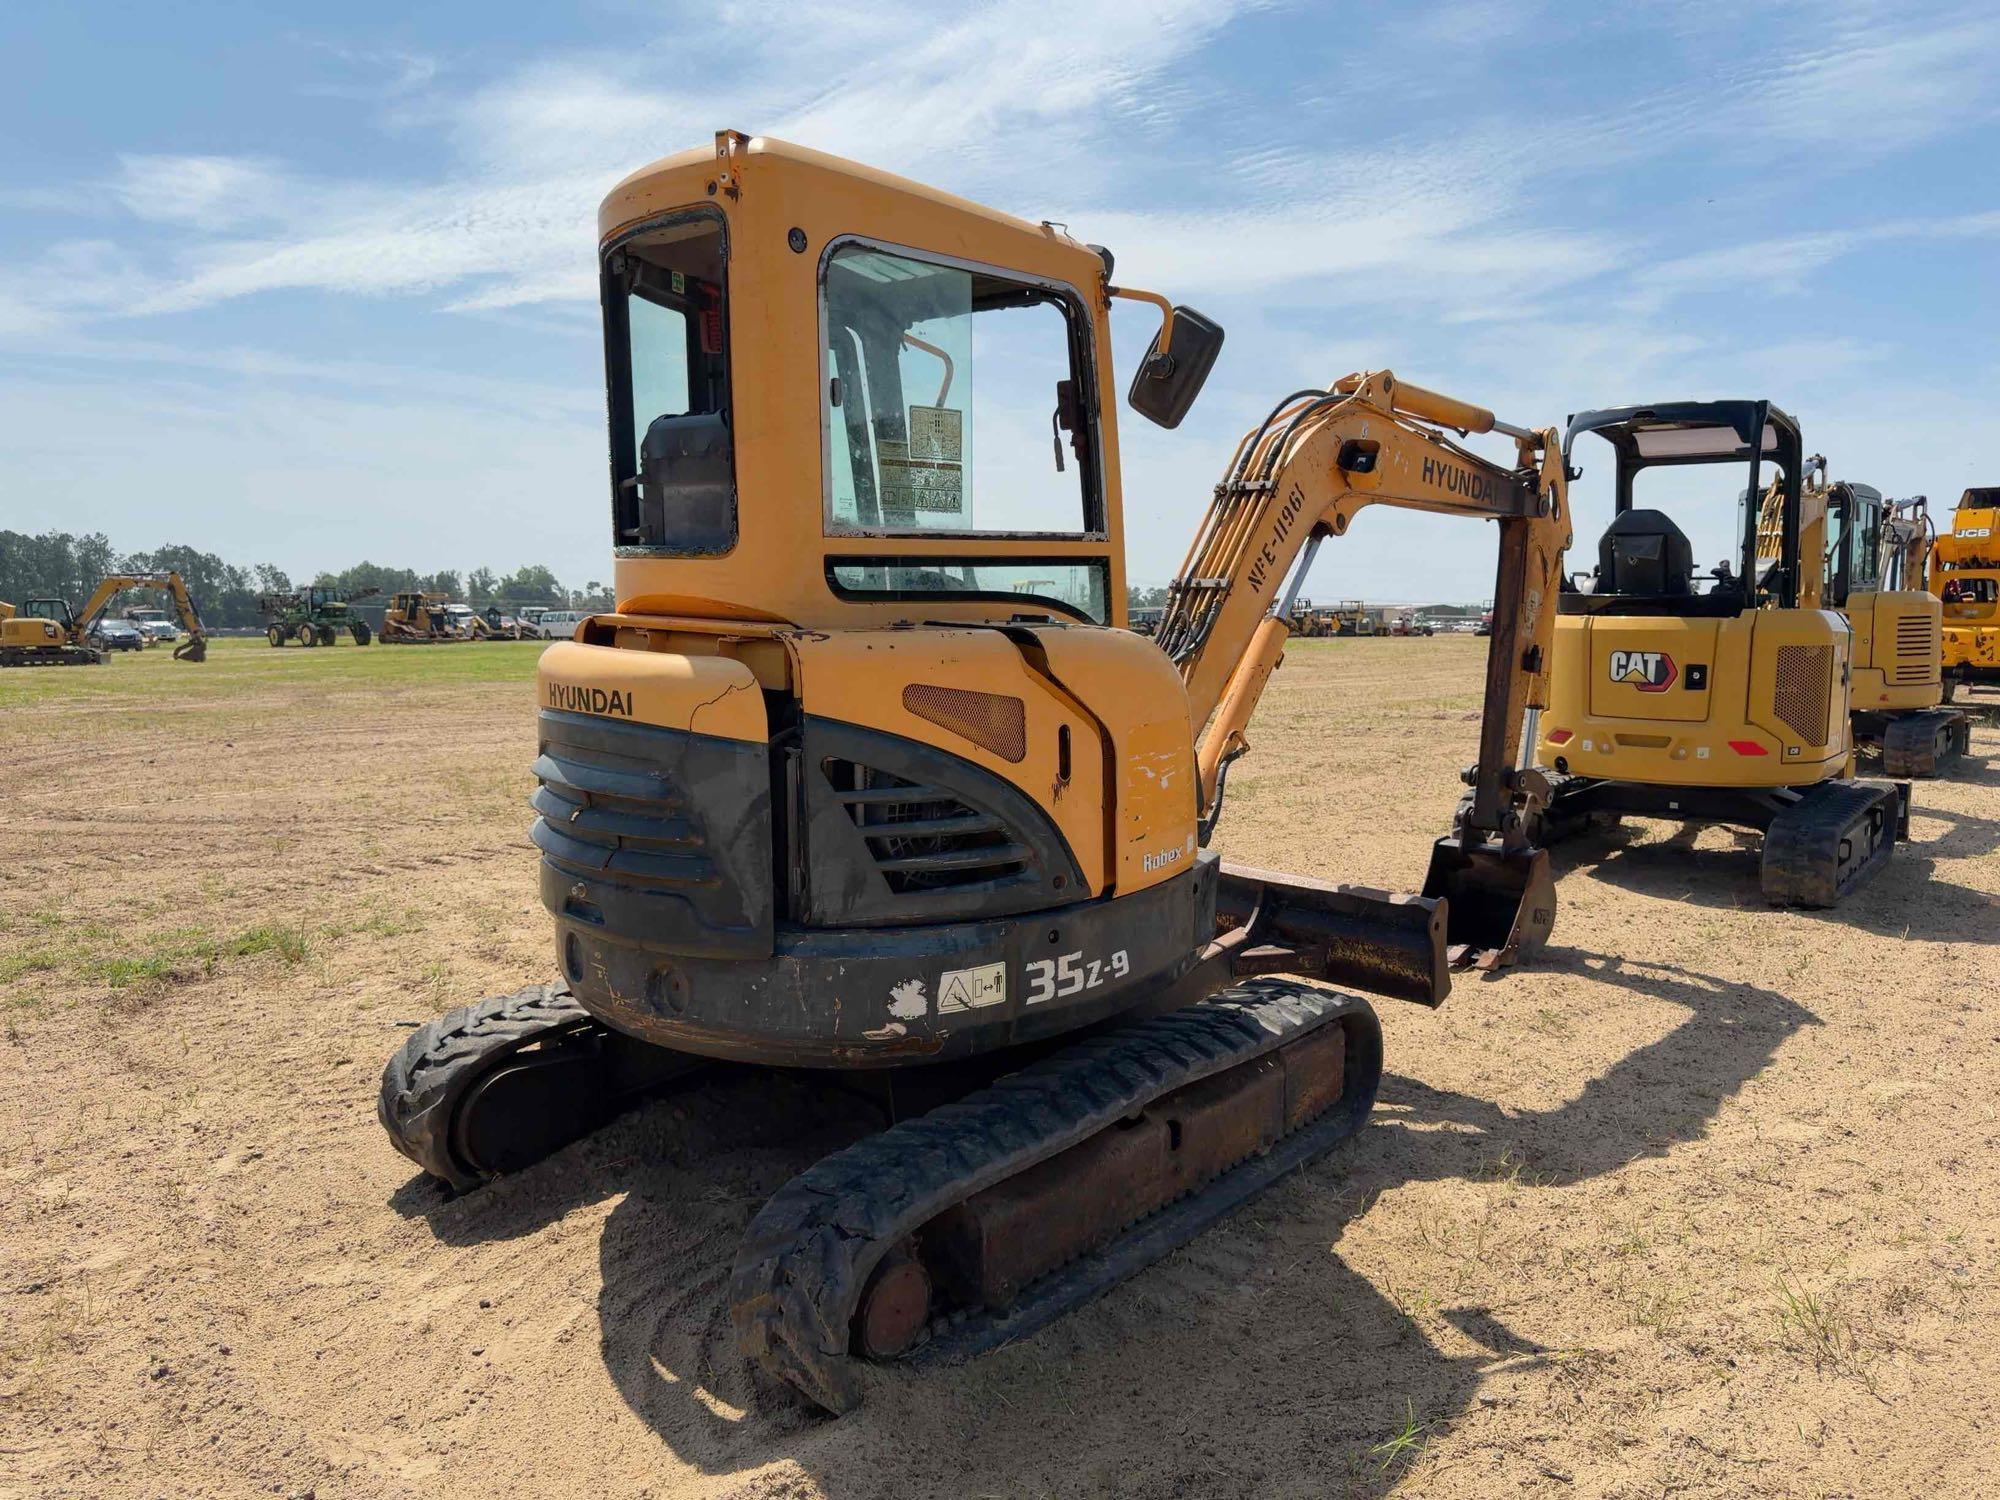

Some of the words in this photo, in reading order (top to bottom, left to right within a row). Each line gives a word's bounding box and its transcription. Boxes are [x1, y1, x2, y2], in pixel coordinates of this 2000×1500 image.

[1955, 529, 1991, 538] JCB
[1610, 651, 1661, 683] CAT
[549, 682, 633, 715] HYUNDAI
